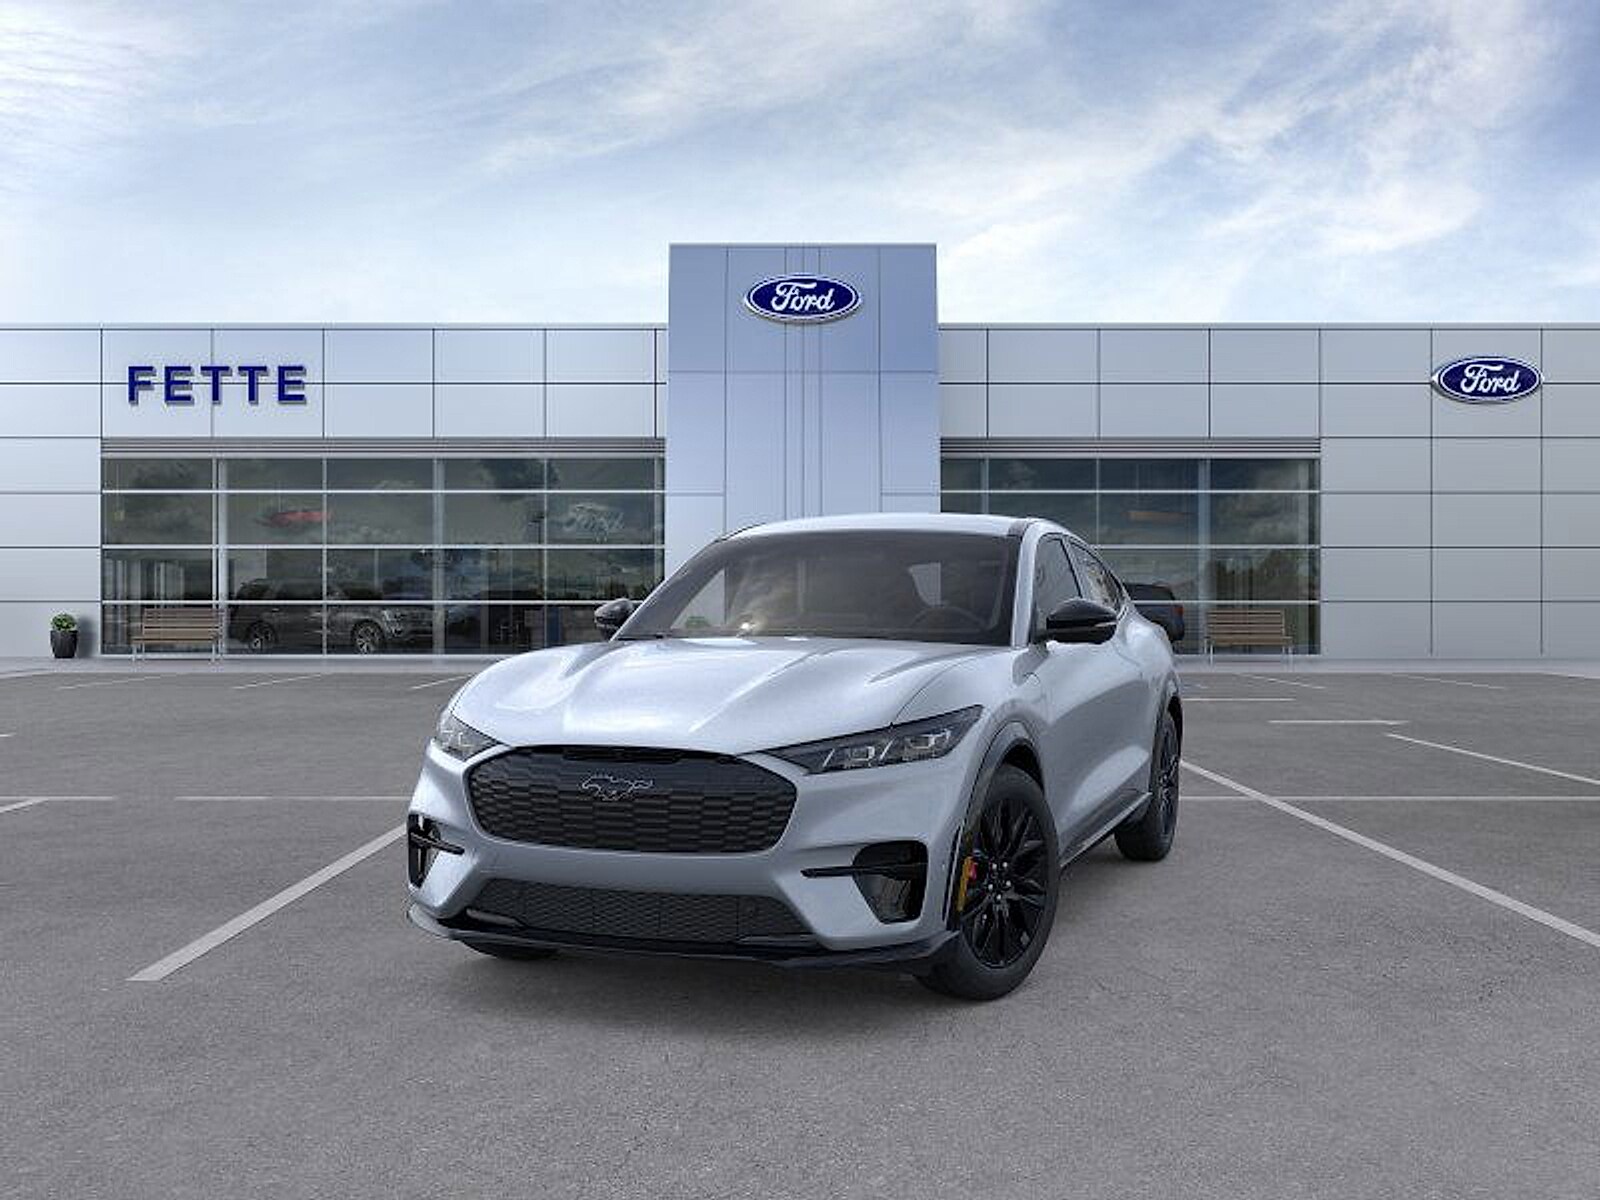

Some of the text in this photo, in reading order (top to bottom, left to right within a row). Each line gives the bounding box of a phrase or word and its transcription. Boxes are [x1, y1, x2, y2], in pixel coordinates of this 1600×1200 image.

[771, 282, 835, 311] Ford
[128, 365, 306, 403] FETTE
[1461, 364, 1521, 393] Ford
